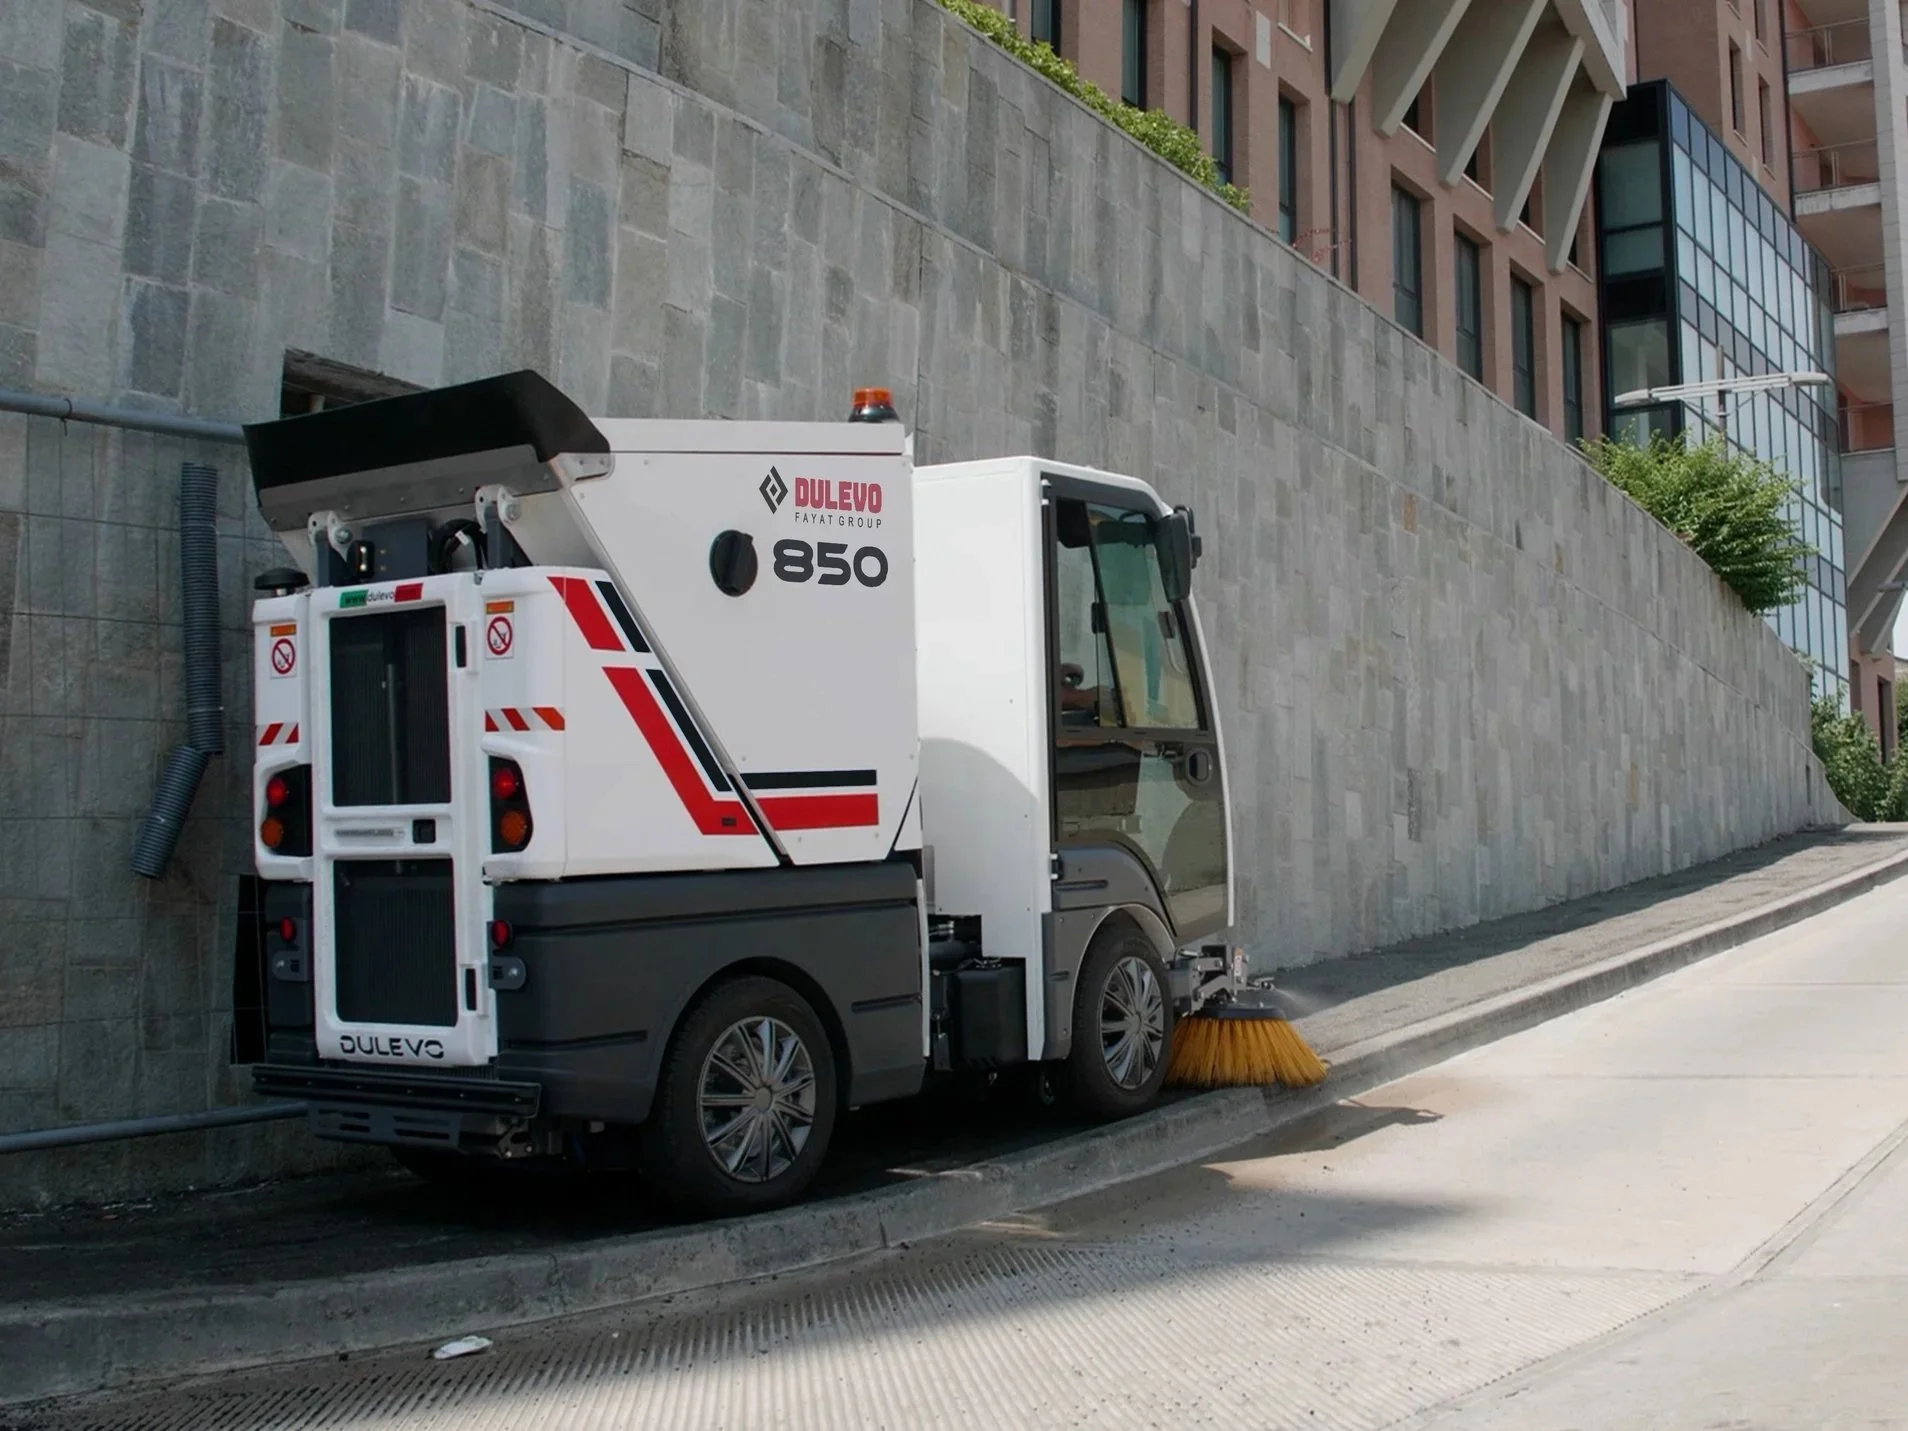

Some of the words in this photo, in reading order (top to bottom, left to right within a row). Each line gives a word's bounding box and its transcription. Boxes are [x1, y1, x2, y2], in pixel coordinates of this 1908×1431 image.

[794, 477, 882, 514] DULEVO
[795, 512, 833, 525] FAYAT
[838, 515, 882, 529] GROUP
[773, 539, 889, 588] 850
[340, 1035, 444, 1059] DULEVO
